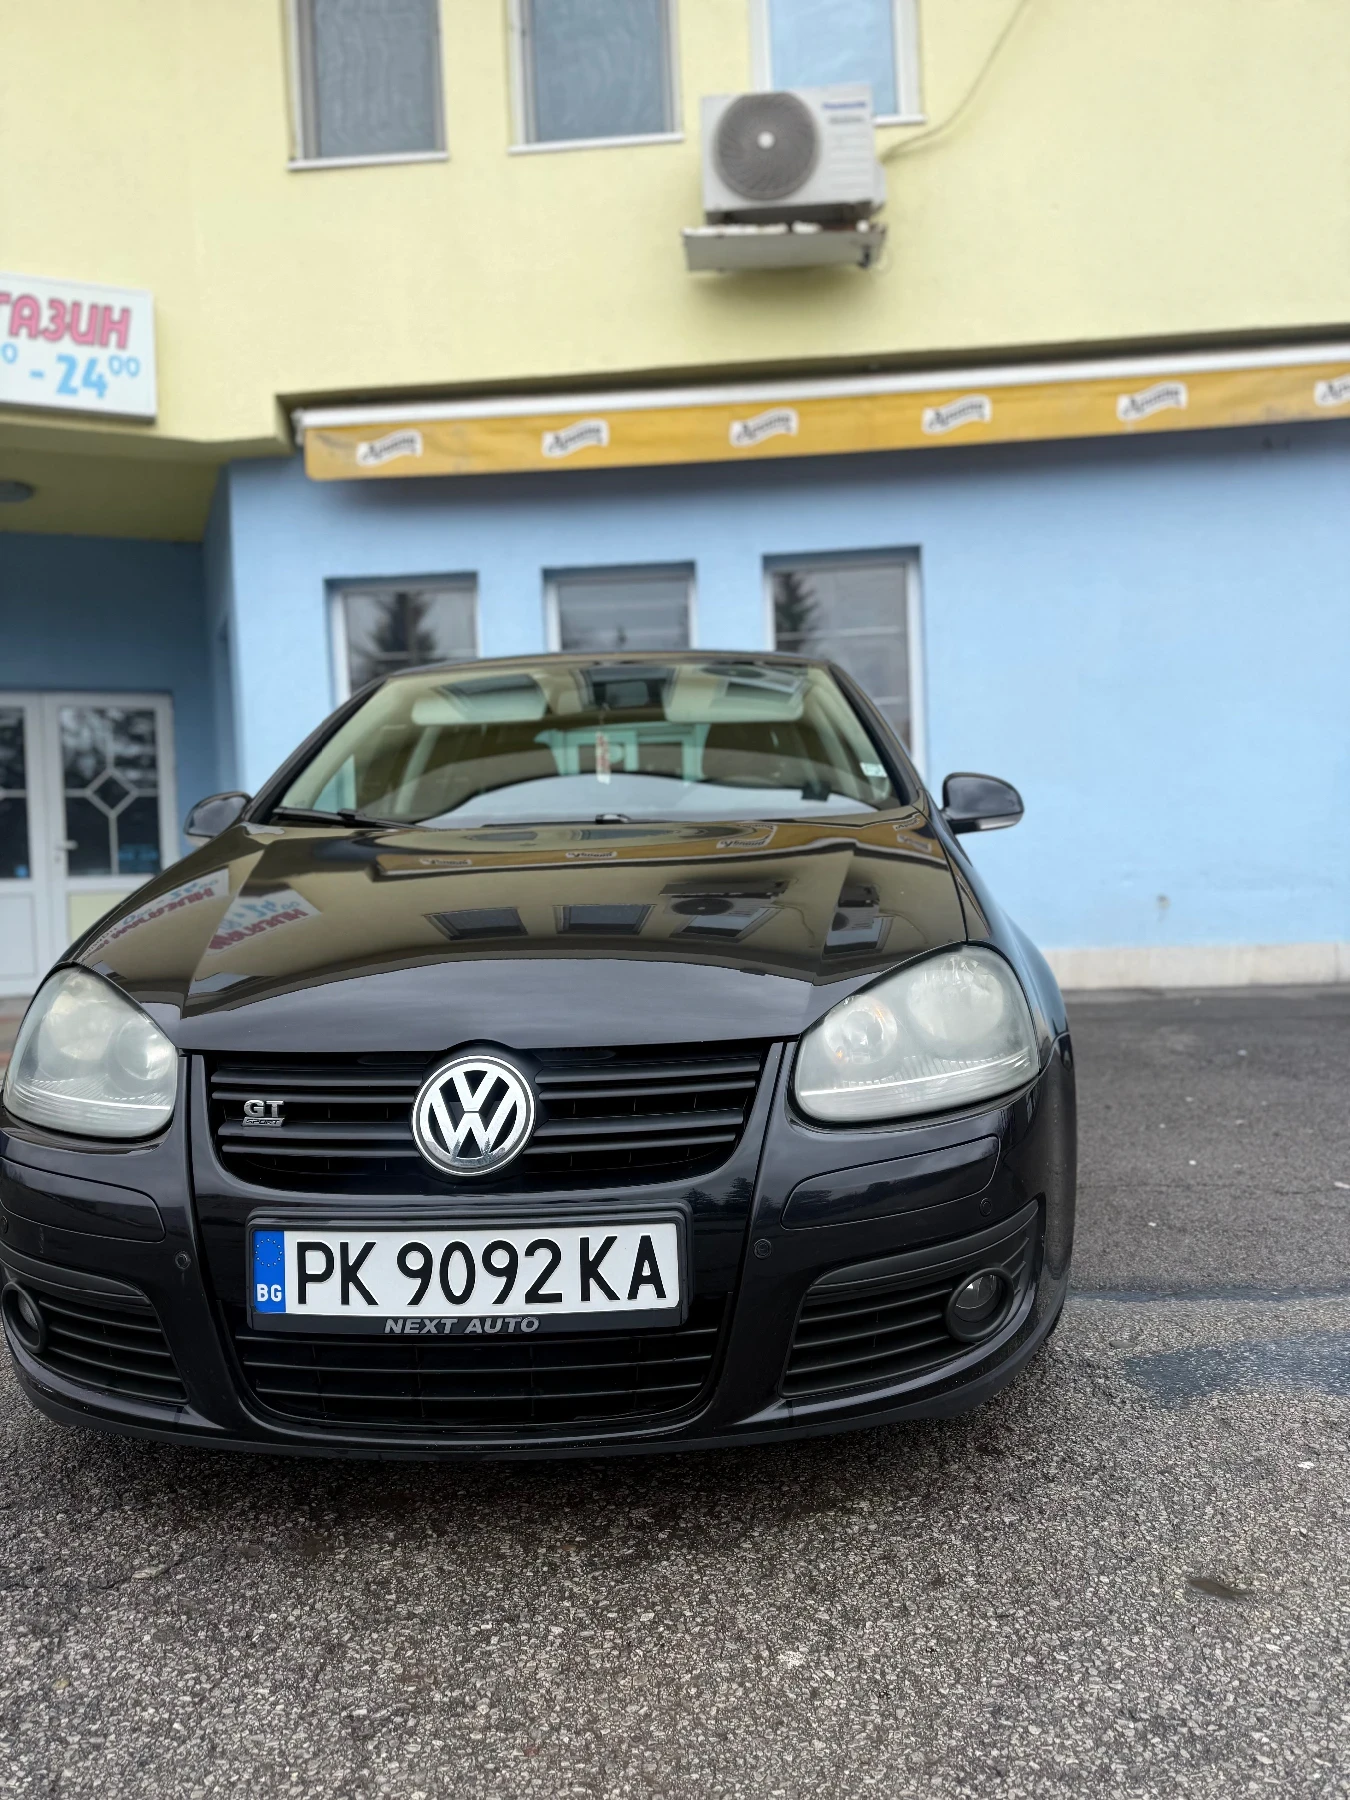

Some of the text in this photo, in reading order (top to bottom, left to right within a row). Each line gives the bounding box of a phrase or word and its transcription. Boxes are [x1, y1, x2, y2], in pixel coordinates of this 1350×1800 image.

[243, 1099, 285, 1118] GT
[418, 1060, 529, 1171] VW
[245, 1118, 281, 1126] SPORT
[297, 1234, 668, 1306] PK 9092 KA
[256, 1283, 283, 1303] BG
[384, 1316, 540, 1334] NEXT AUTO
